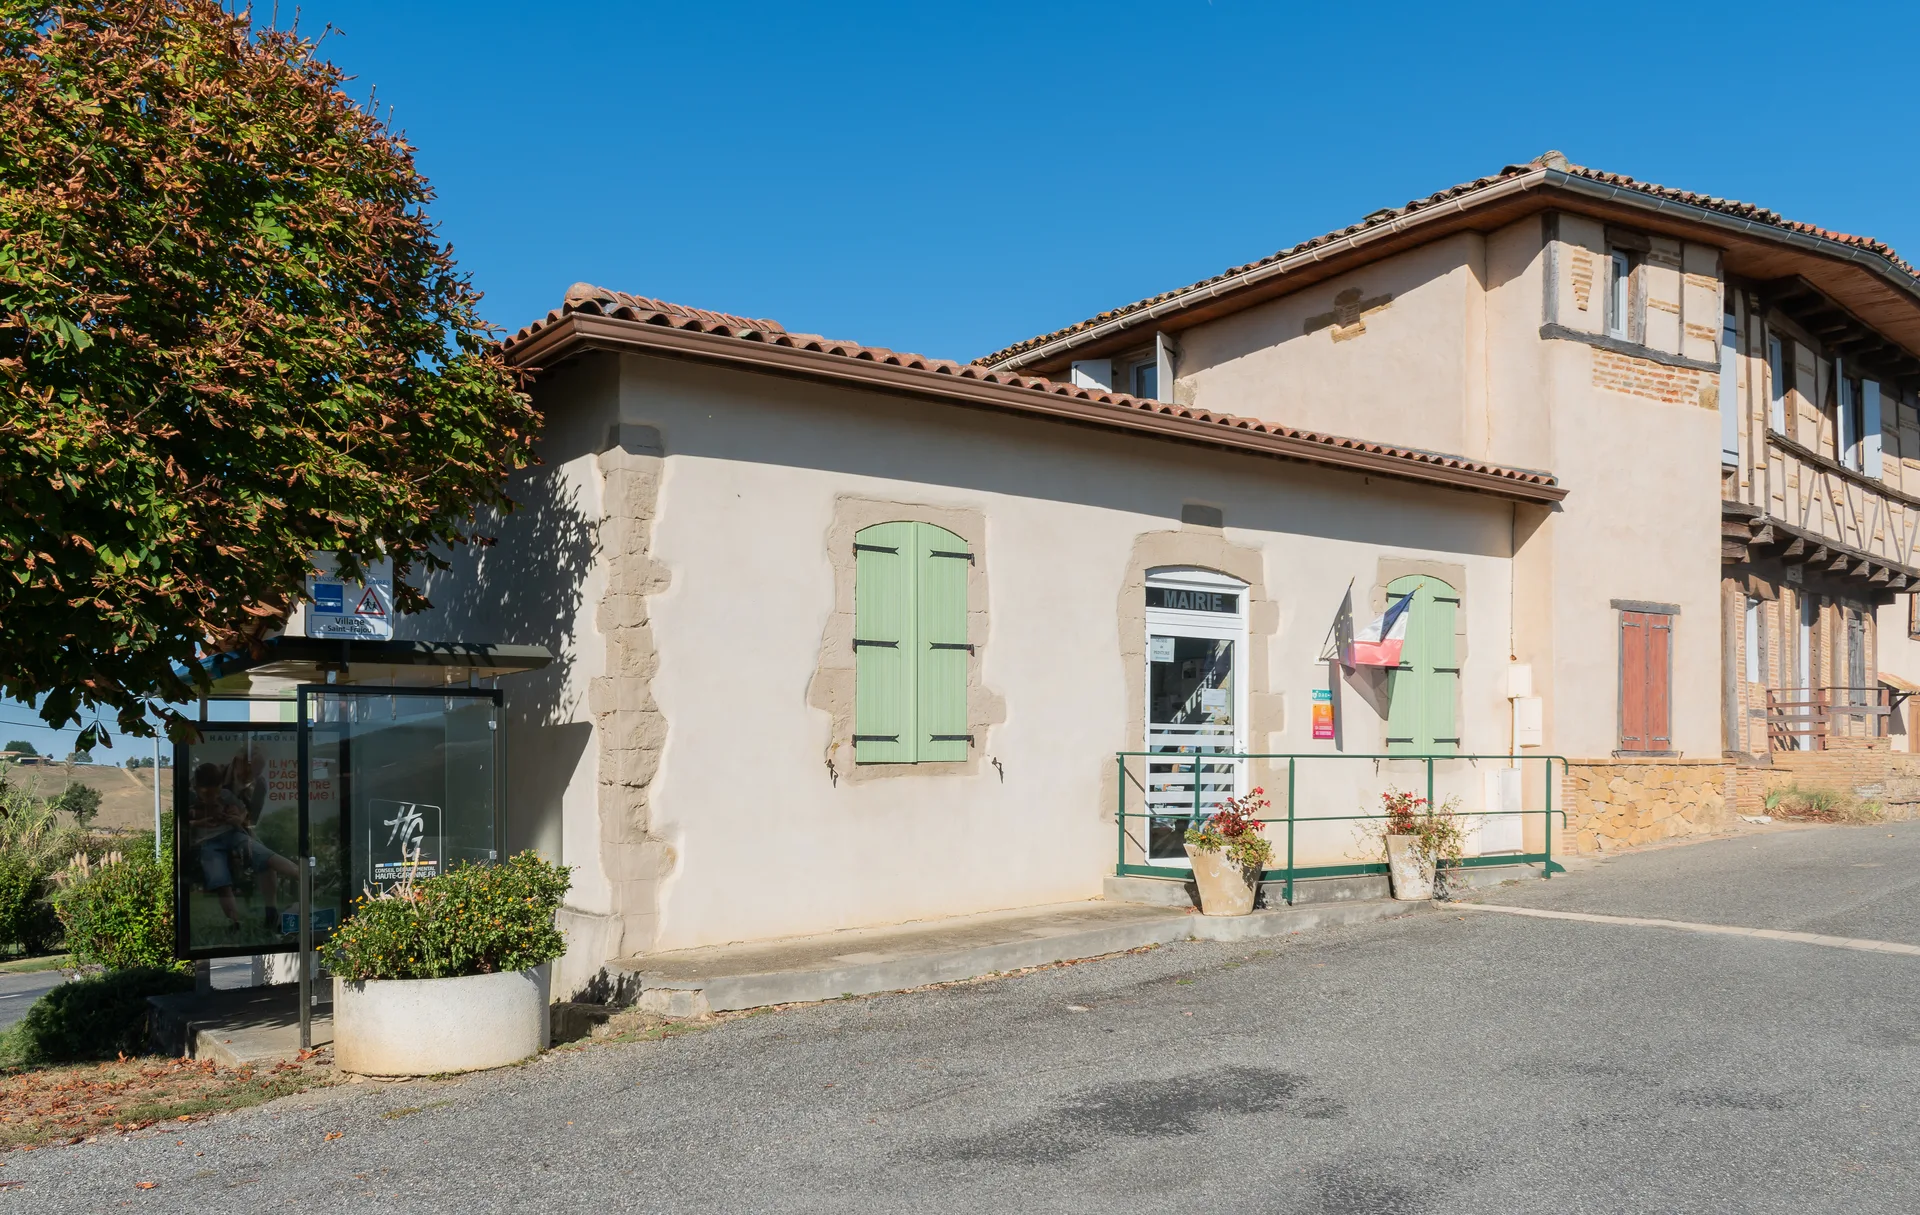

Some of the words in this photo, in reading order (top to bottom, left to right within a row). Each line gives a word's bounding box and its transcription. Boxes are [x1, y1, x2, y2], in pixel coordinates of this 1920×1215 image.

[1163, 590, 1222, 611] MAIRIE
[335, 617, 365, 626] Village
[269, 760, 277, 768] IL
[269, 769, 298, 779] D'ÂG
[383, 804, 424, 861] HG
[375, 871, 437, 880] HAUTE-GARNNE.FR
